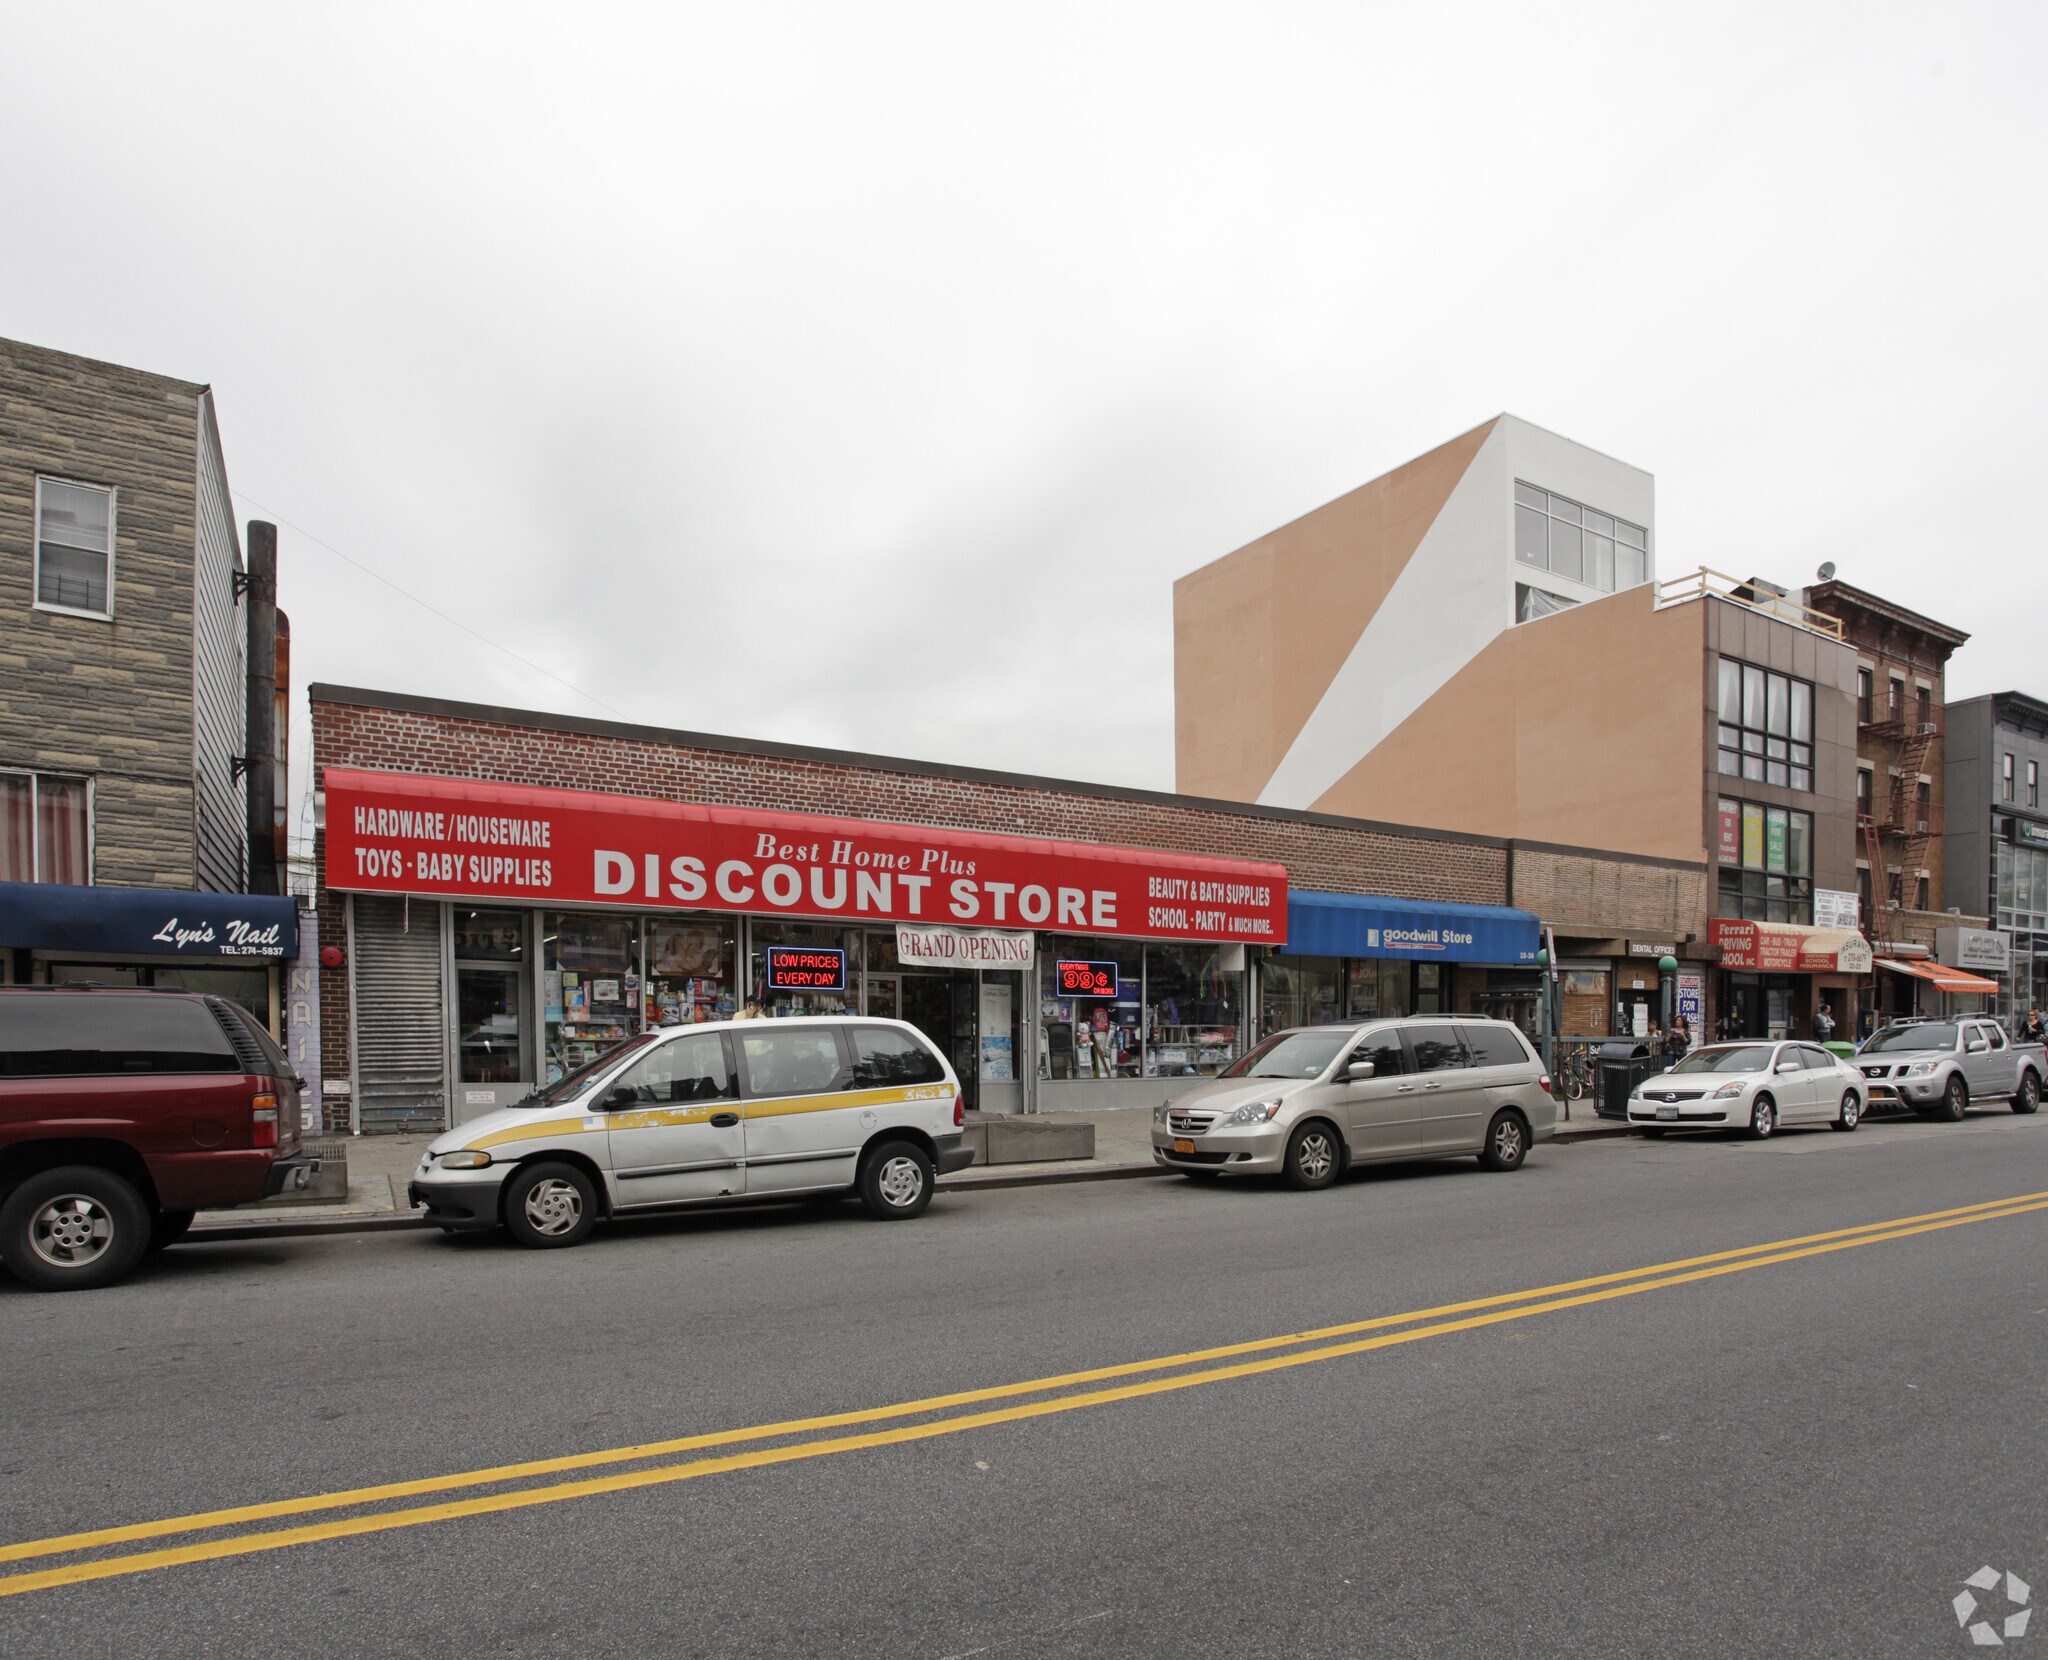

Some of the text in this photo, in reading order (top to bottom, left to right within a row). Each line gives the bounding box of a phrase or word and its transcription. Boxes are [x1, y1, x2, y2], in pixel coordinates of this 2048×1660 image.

[1770, 827, 1781, 837] FOR
[1770, 841, 1782, 851] SALE
[753, 833, 976, 876] Best Home Plus
[354, 847, 552, 887] TOYS BABY SUPPLIES
[594, 849, 1118, 928] DISCOUNT STORE
[1148, 876, 1270, 907] BEAUTY & BATH SUPPLIES
[1148, 906, 1189, 930] SCHOOL
[1195, 910, 1226, 932] PARTY
[1228, 916, 1233, 932] &
[1234, 917, 1252, 934] MUCH
[152, 917, 280, 949] Lyn's Nail
[1382, 928, 1473, 944] goodwill Store
[1718, 923, 1755, 935] Ferrari
[900, 931, 1030, 961] GRAND OPENING
[1760, 936, 1798, 947] CAR BUS TRUCK
[1632, 944, 1676, 955] DENTAL OFFICES
[1760, 947, 1796, 957] TRACTOR TRAILER
[773, 954, 840, 969] LOW PRICES
[1763, 958, 1792, 968] MOTORCYCLE
[776, 971, 835, 985] EVERY DAY
[1679, 987, 1699, 998] STORE
[1682, 1000, 1696, 1011] FOR
